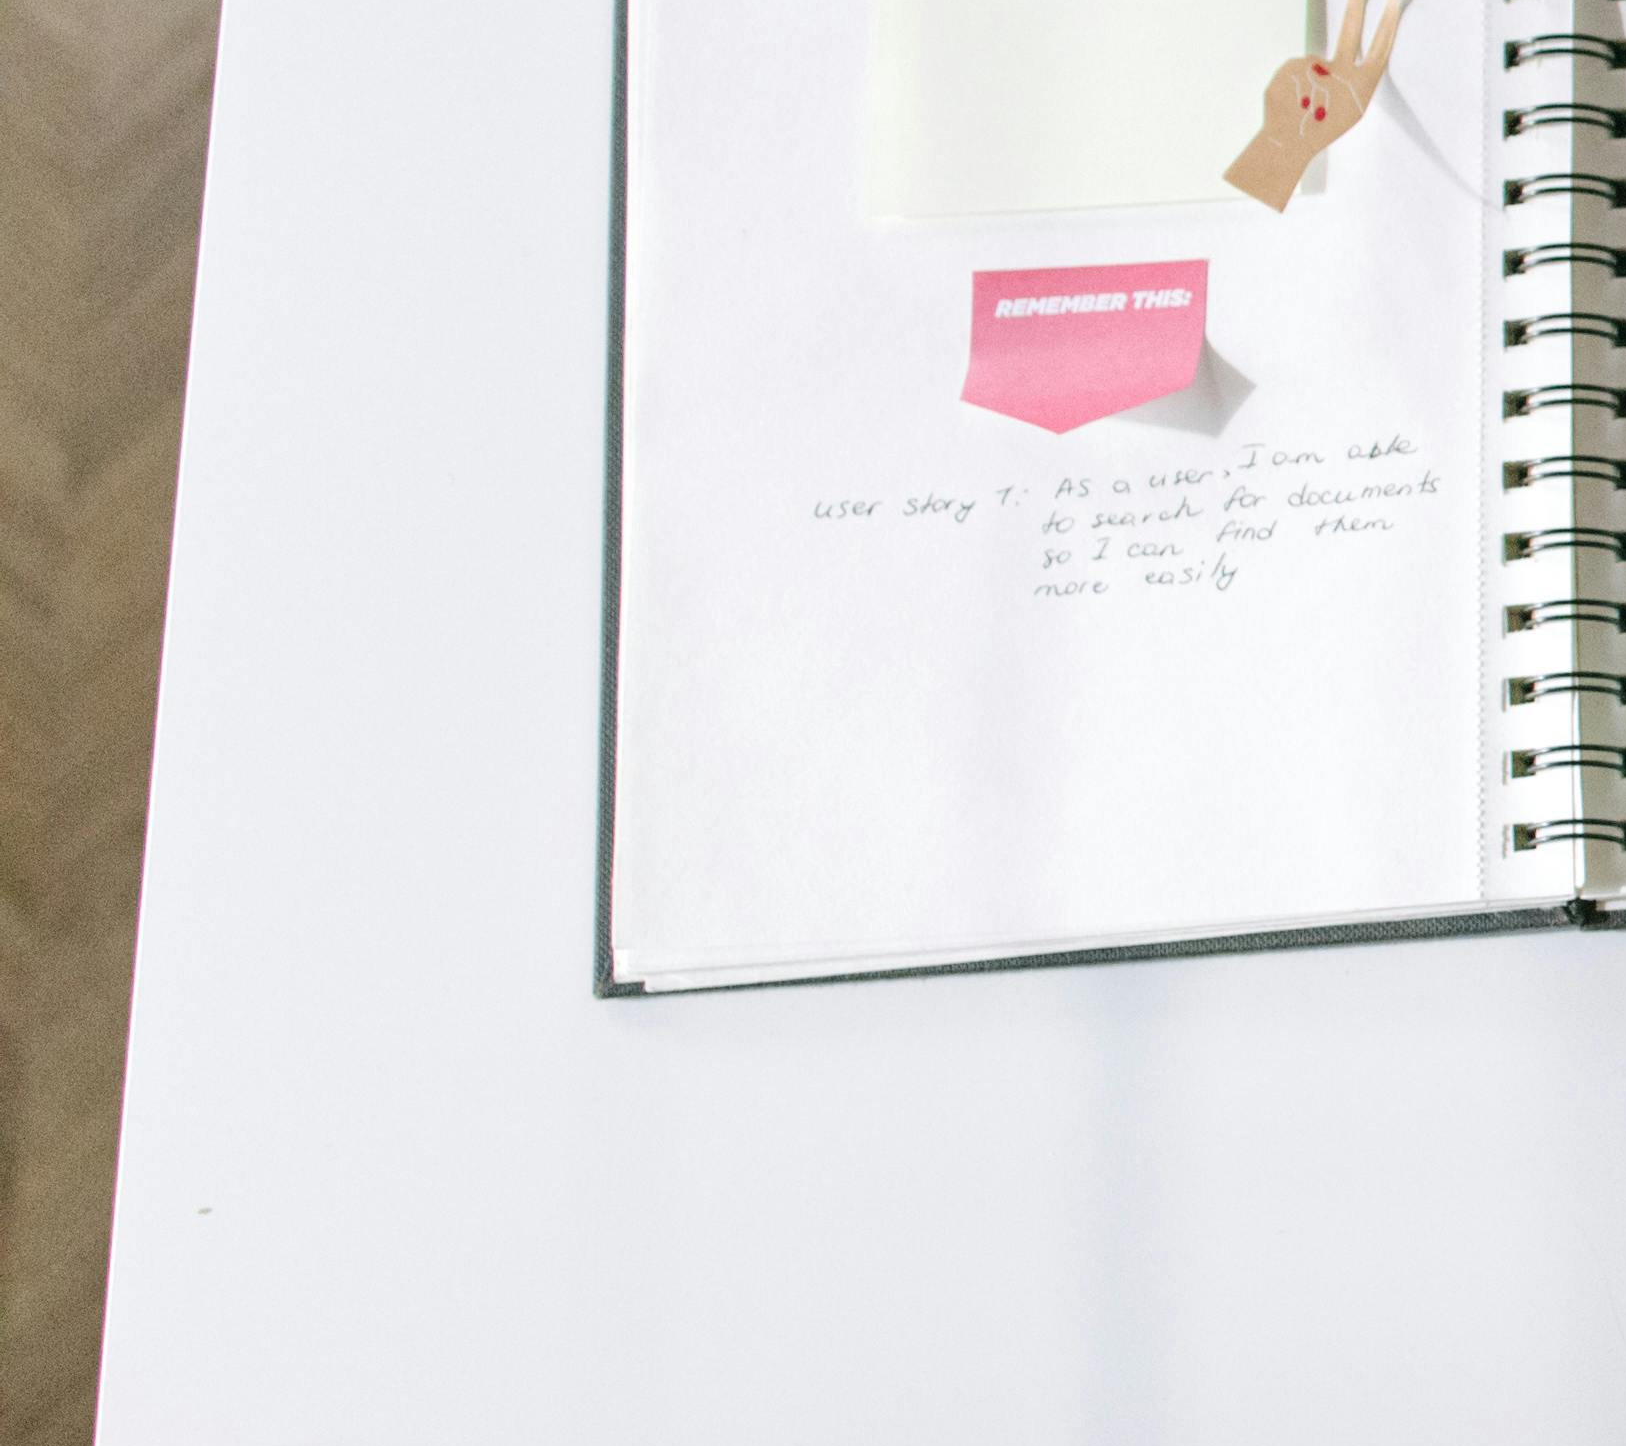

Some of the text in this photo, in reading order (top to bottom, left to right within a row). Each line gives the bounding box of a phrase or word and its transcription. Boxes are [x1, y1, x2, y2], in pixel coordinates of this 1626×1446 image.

[994, 288, 1192, 319] REMEMBER THIS:
[1272, 447, 1327, 467] am
[813, 495, 977, 524] user story
[1042, 471, 1442, 535] to search for documents
[1042, 514, 1397, 570] so I can find them
[1033, 554, 1239, 597] more easily
